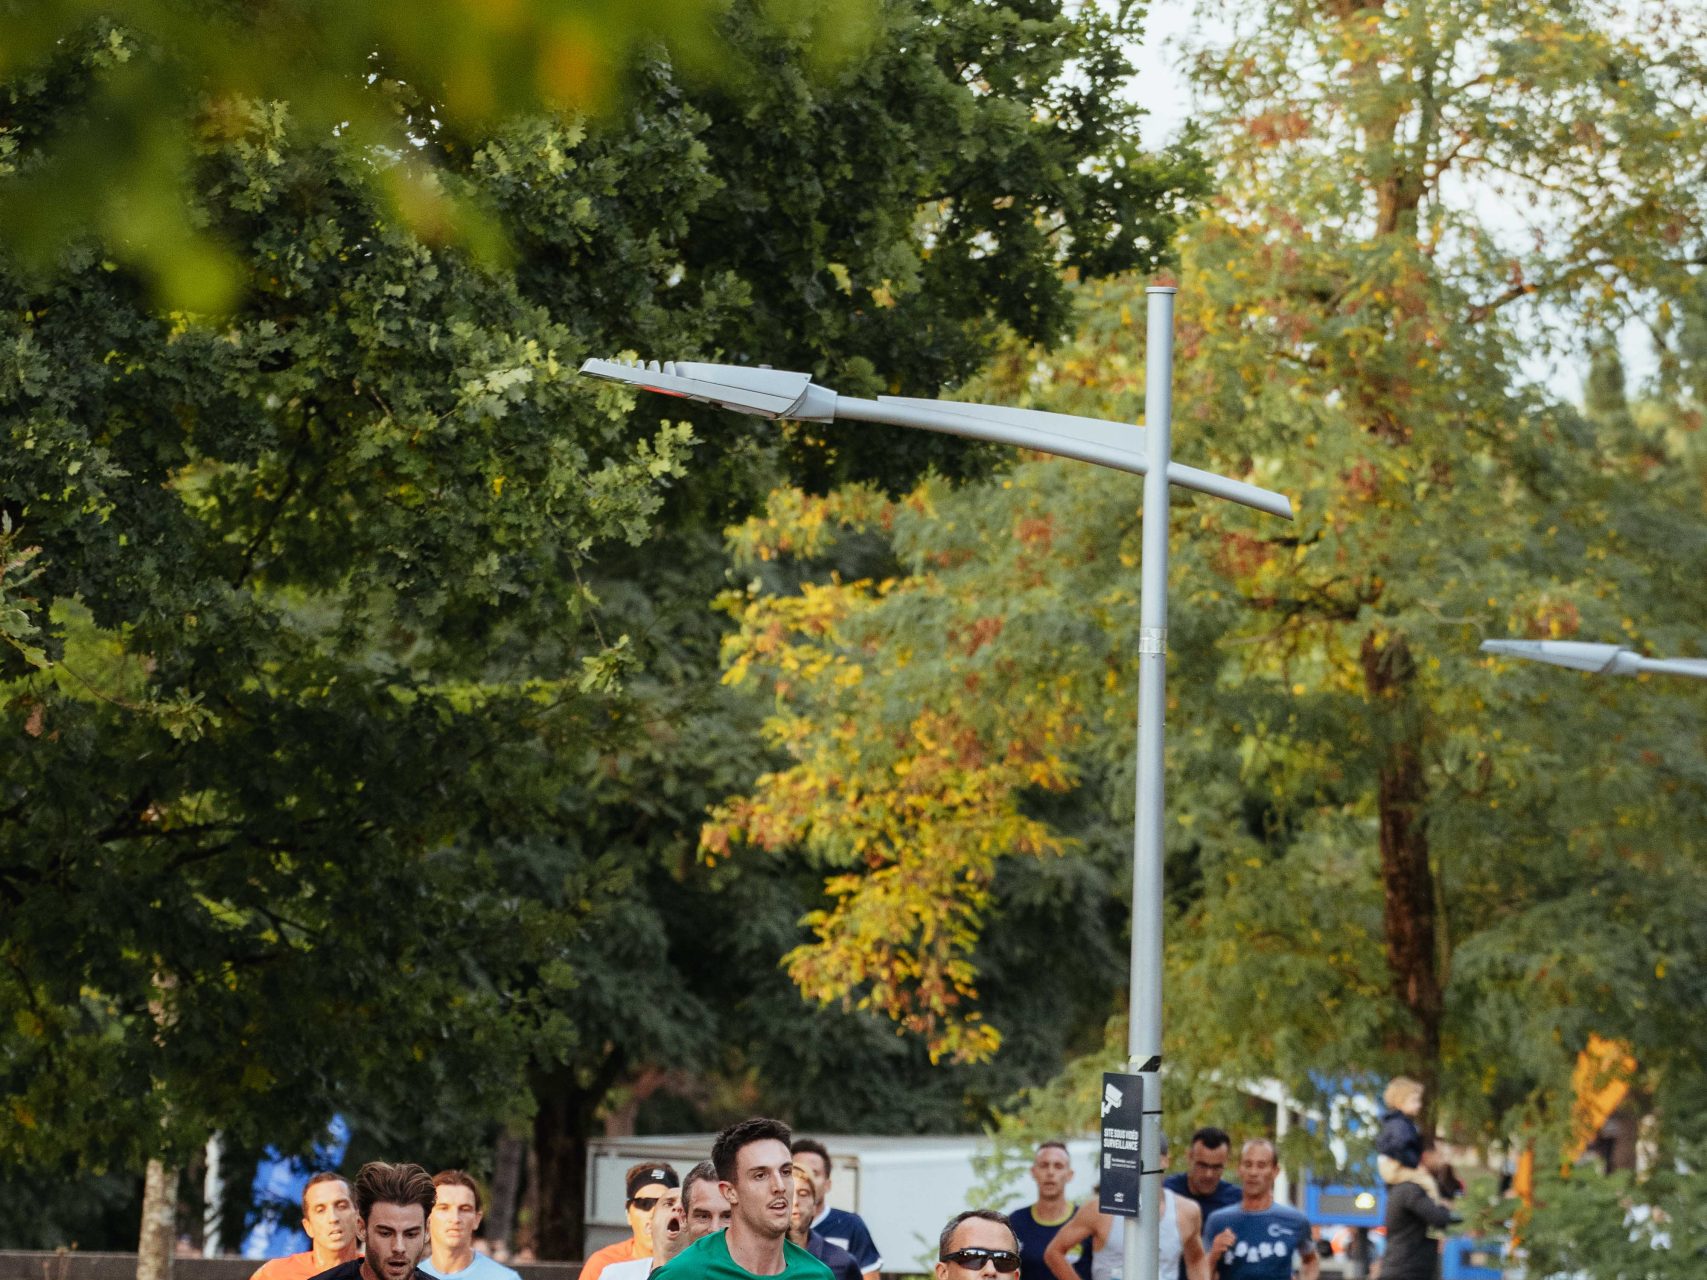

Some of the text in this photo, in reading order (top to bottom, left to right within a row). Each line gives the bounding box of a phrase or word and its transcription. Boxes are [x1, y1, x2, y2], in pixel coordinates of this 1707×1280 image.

[1103, 1128, 1114, 1138] SITE
[1114, 1129, 1126, 1139] SOUS
[1103, 1138, 1139, 1151] SURVEILLANCE
